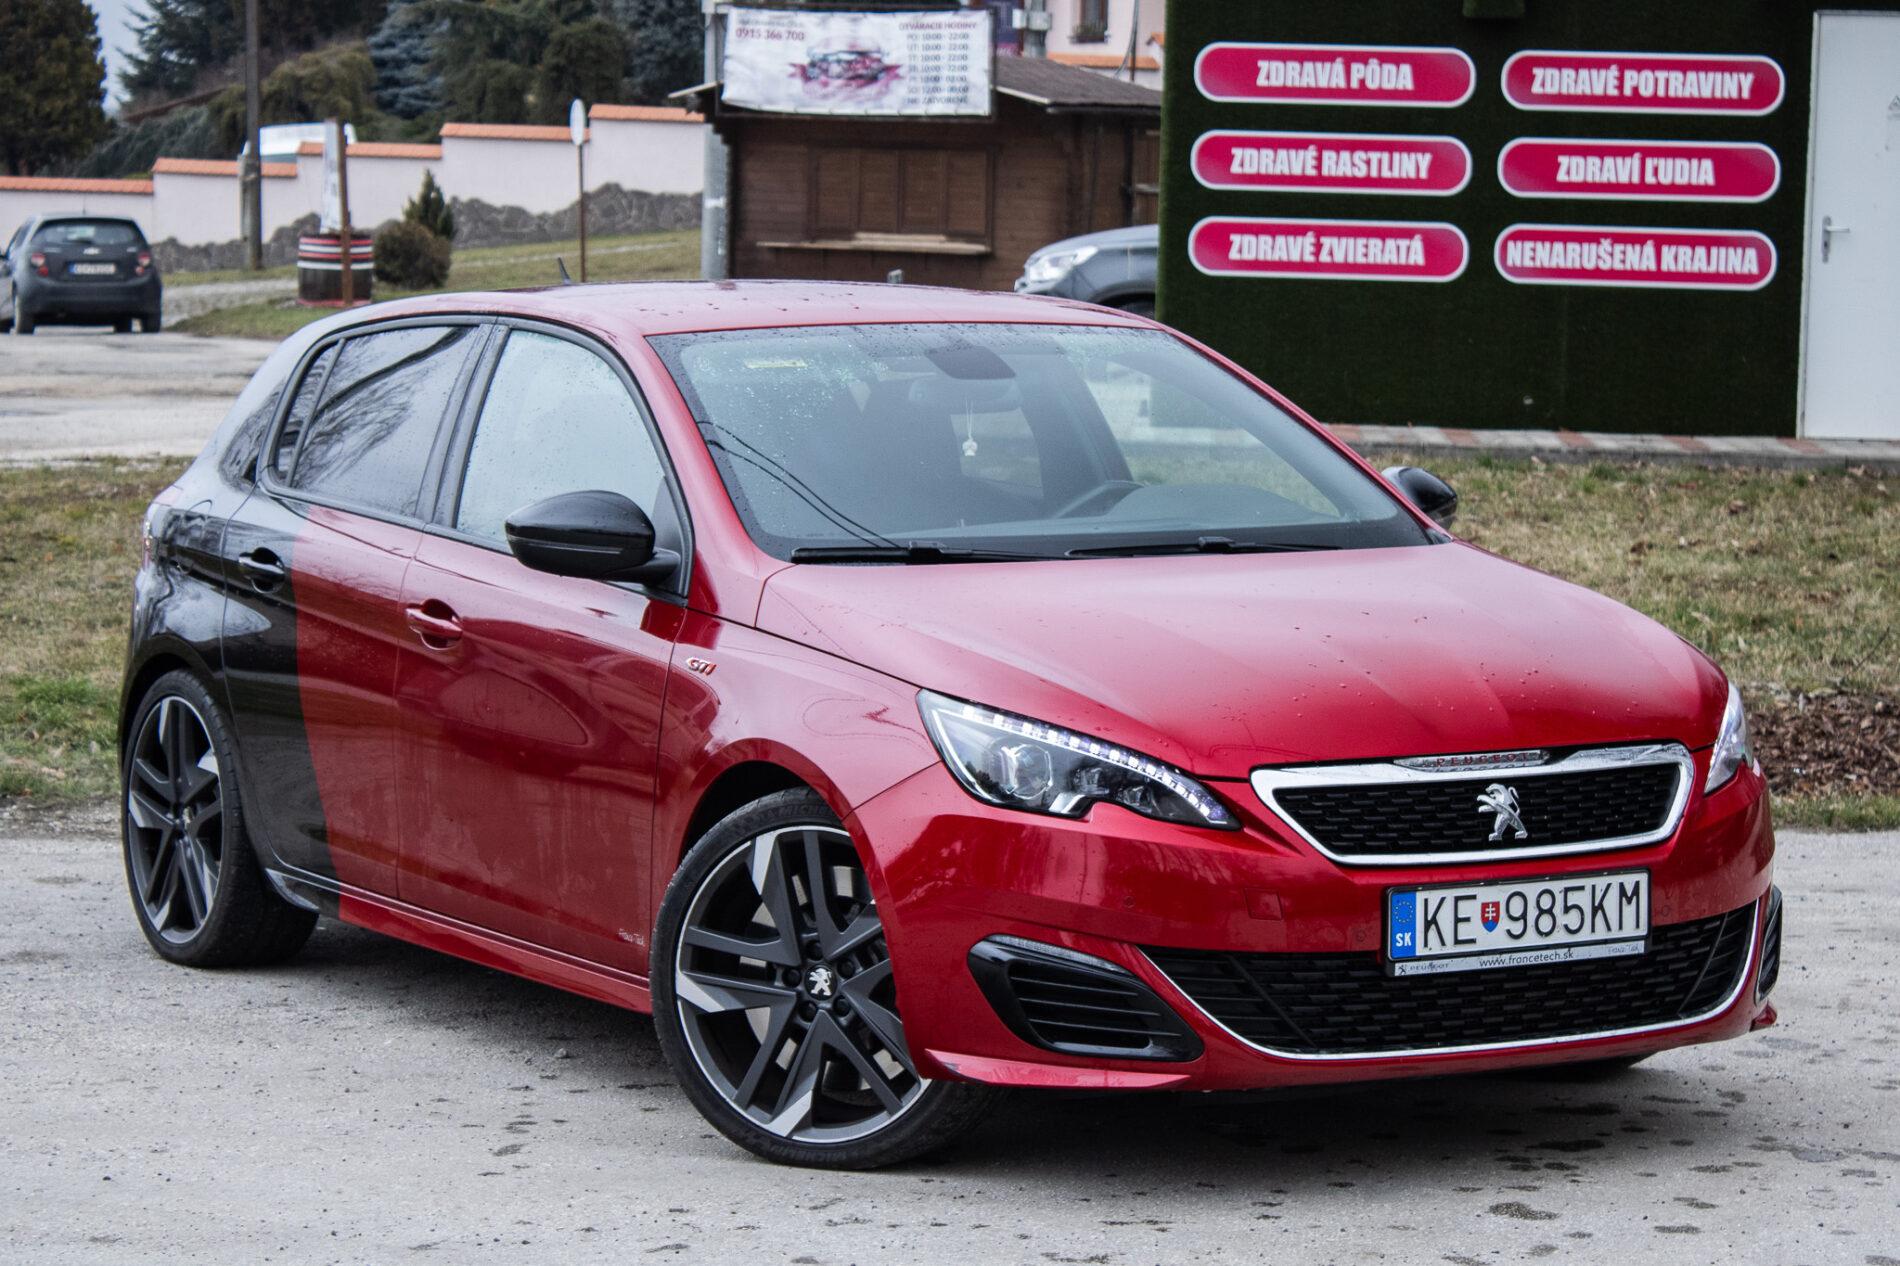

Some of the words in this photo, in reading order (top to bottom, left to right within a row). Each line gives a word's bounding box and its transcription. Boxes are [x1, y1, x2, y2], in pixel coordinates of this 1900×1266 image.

[1255, 57, 1347, 89] ZDRAVÁ
[1350, 58, 1415, 91] PÔDA
[1531, 64, 1620, 96] ZDRAVÉ
[1623, 69, 1755, 100] POTRAVINY
[1230, 145, 1318, 176] ZDRAVÉ
[1321, 150, 1432, 179] RASTLINY
[1556, 152, 1642, 184] ZDRAVÍ
[1644, 157, 1716, 186] ĽUDIA
[1228, 231, 1317, 262] ZDRAVÉ
[1318, 234, 1425, 266] ZVIERATÁ
[1506, 238, 1657, 271] NENARUŠENÁ
[1660, 244, 1759, 275] KRAJINA
[1436, 752, 1530, 767] PEUGEOT
[1423, 894, 1477, 948] KE
[1505, 880, 1641, 940] 985KM
[1395, 932, 1412, 947] SK
